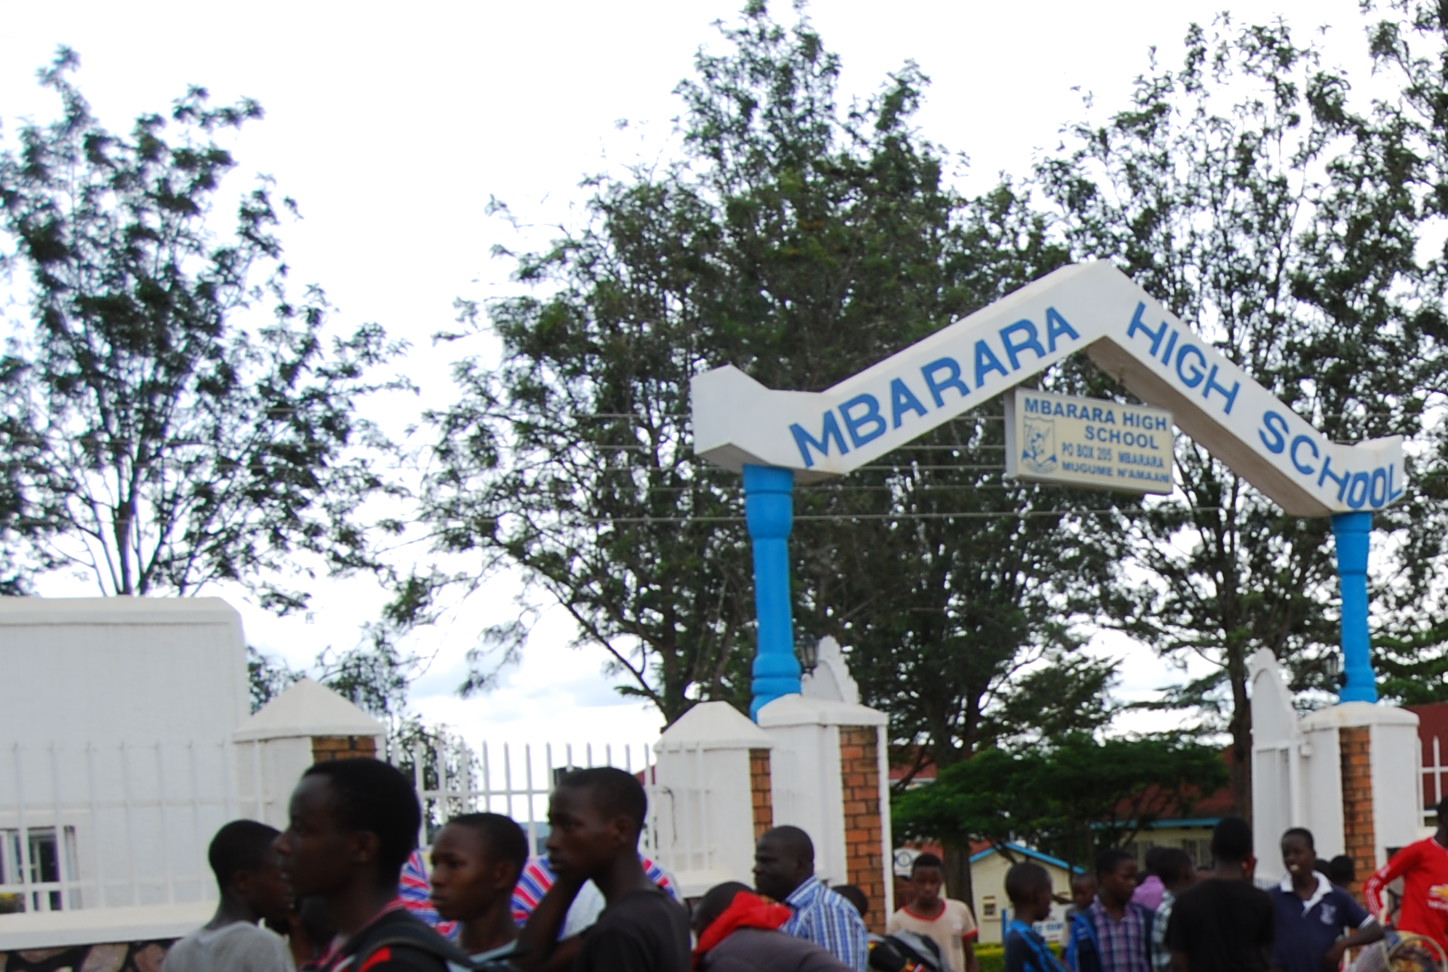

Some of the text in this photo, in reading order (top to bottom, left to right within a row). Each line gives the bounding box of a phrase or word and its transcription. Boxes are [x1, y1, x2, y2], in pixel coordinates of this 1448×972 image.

[789, 300, 1403, 509] MBARARA HIGH SCHOOL
[1024, 397, 1168, 431] MBARARA HIGH
[1084, 425, 1160, 450] SCHOOL
[1061, 442, 1074, 457] PO
[1076, 443, 1095, 459] BOX
[1118, 451, 1165, 469] MBARARA
[1062, 461, 1113, 477] MUGUME
